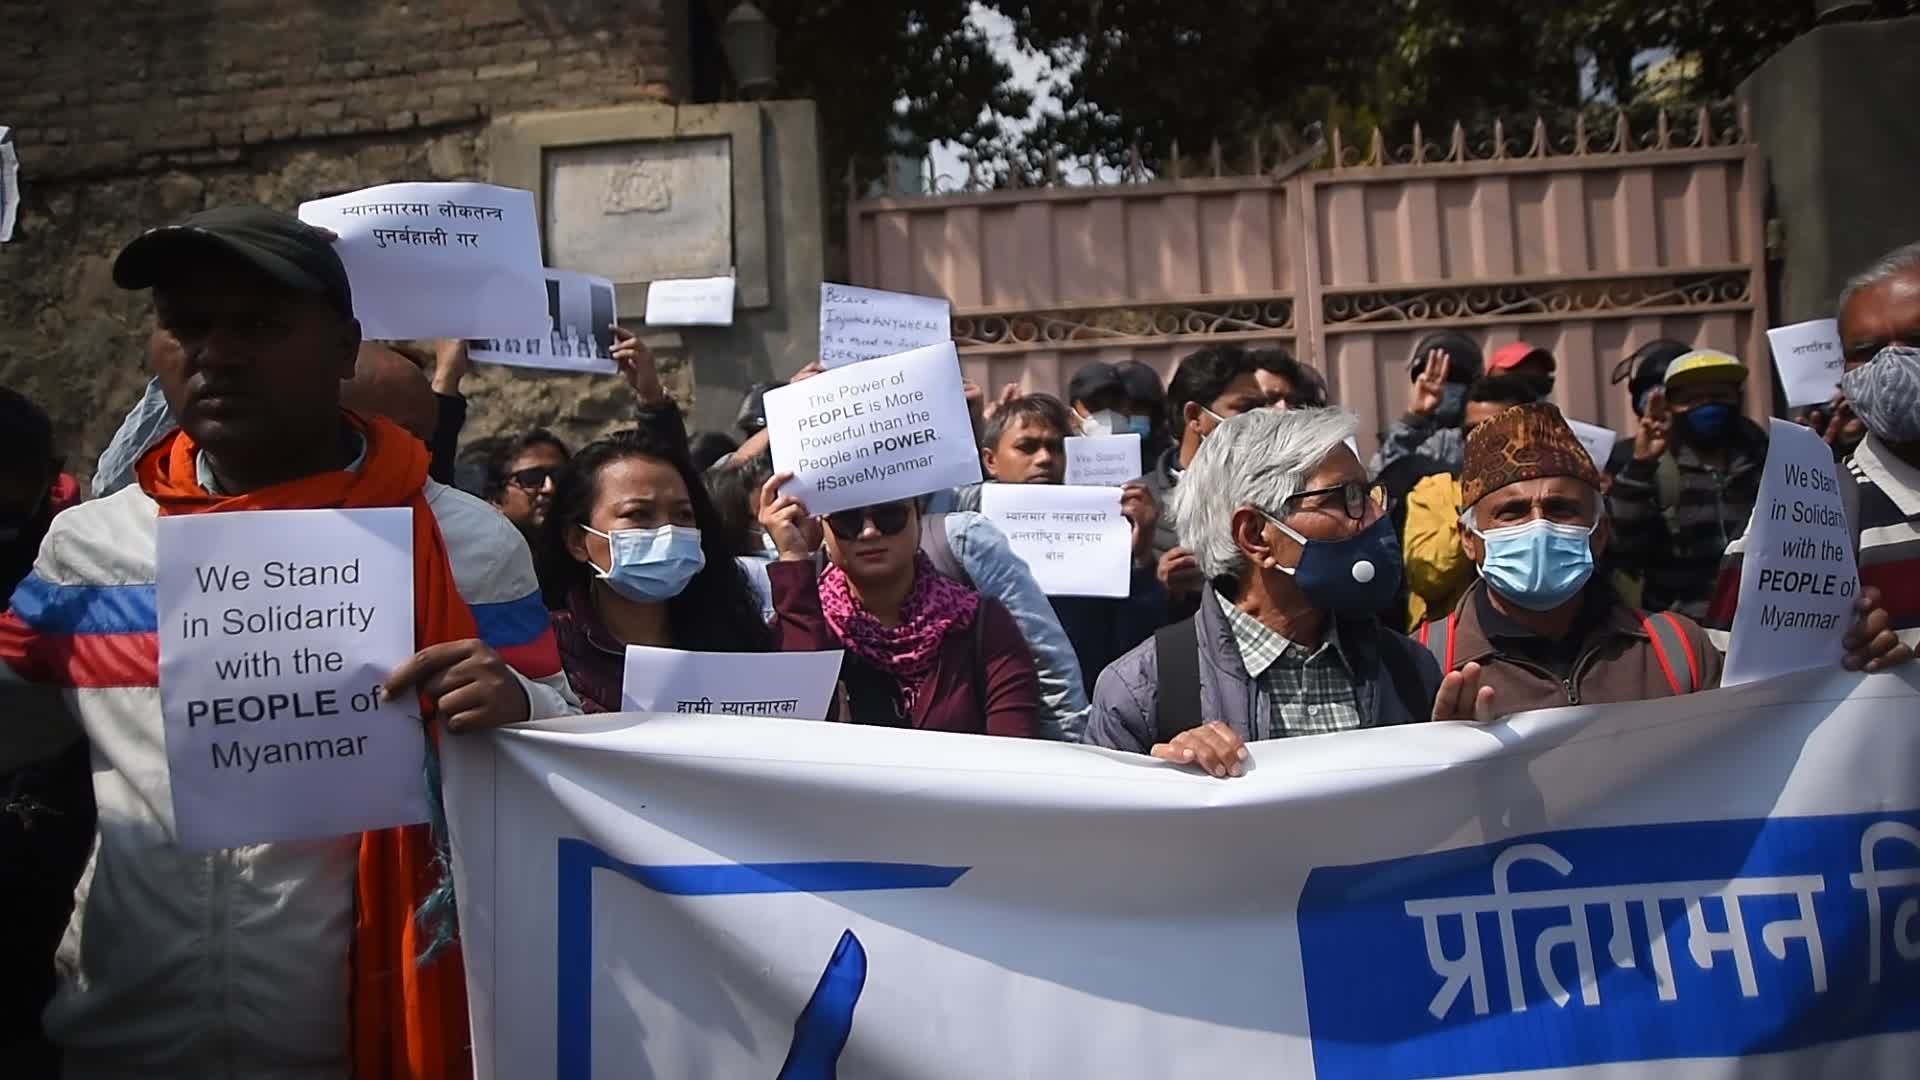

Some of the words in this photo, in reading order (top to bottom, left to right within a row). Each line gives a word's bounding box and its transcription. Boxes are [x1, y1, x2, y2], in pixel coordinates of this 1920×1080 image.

[342, 202, 428, 217] म्यानमारमा
[436, 200, 503, 221] लोकतन्त्र
[373, 225, 448, 248] पुनर्बहाली
[456, 233, 479, 248] गर
[809, 392, 834, 408] The
[839, 378, 886, 399] Power
[890, 370, 905, 385] of
[798, 402, 865, 431] PEOPLE
[869, 400, 881, 413] is
[885, 390, 924, 408] More
[800, 423, 866, 451] Powerful
[870, 418, 903, 435] than
[906, 410, 930, 426] the
[798, 449, 851, 473] People
[856, 447, 870, 459] in
[873, 428, 942, 454] POWER.
[816, 454, 935, 493] #SaveMyanmar
[1785, 463, 1808, 488] We
[1771, 498, 1787, 521] in
[1783, 537, 1815, 560] with
[1821, 539, 1843, 562] the
[196, 565, 250, 593] We
[263, 558, 360, 588] Stand
[1758, 569, 1836, 595] PEOPLE
[1840, 576, 1856, 598] of
[183, 612, 208, 638] in
[222, 602, 375, 635] Solidarity
[1761, 604, 1840, 631] Myanmar
[216, 650, 280, 680] with
[293, 648, 343, 674] the
[188, 689, 339, 727] PEOPLE
[351, 685, 381, 713] of
[676, 696, 714, 714] हामी
[720, 699, 799, 715] म्यानमारका
[212, 735, 369, 773] Myanmar
[1404, 843, 1828, 1021] प्रतिगमन
